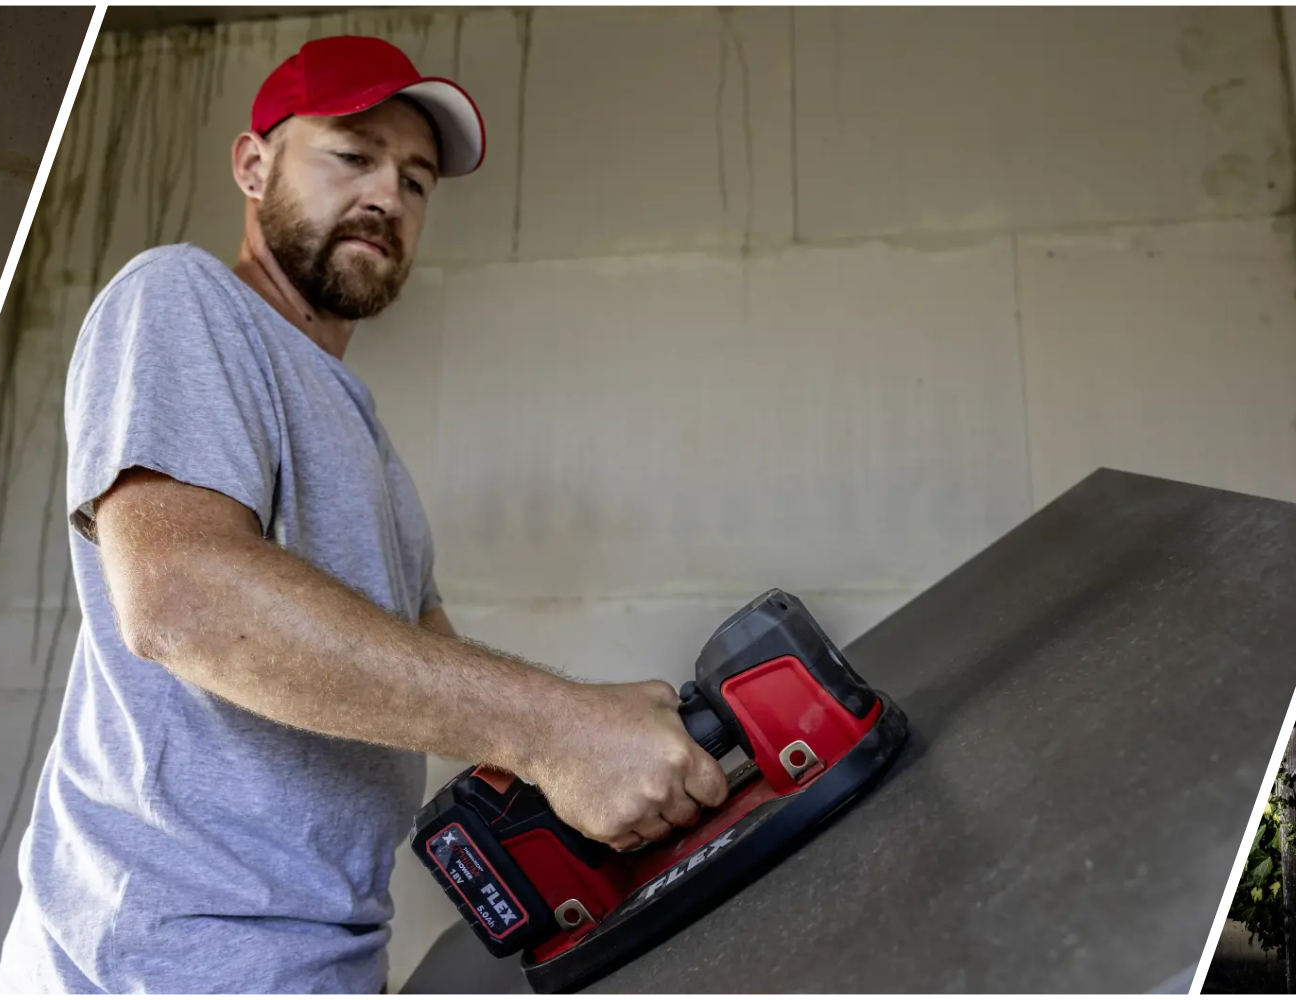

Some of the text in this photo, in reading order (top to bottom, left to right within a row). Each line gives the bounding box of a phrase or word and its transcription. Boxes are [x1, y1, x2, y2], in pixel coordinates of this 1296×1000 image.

[450, 868, 465, 884] 18V
[455, 859, 474, 881] POWER
[645, 828, 736, 900] FLEX
[476, 904, 496, 928] 5.0Ah
[480, 882, 518, 926] FLEX
